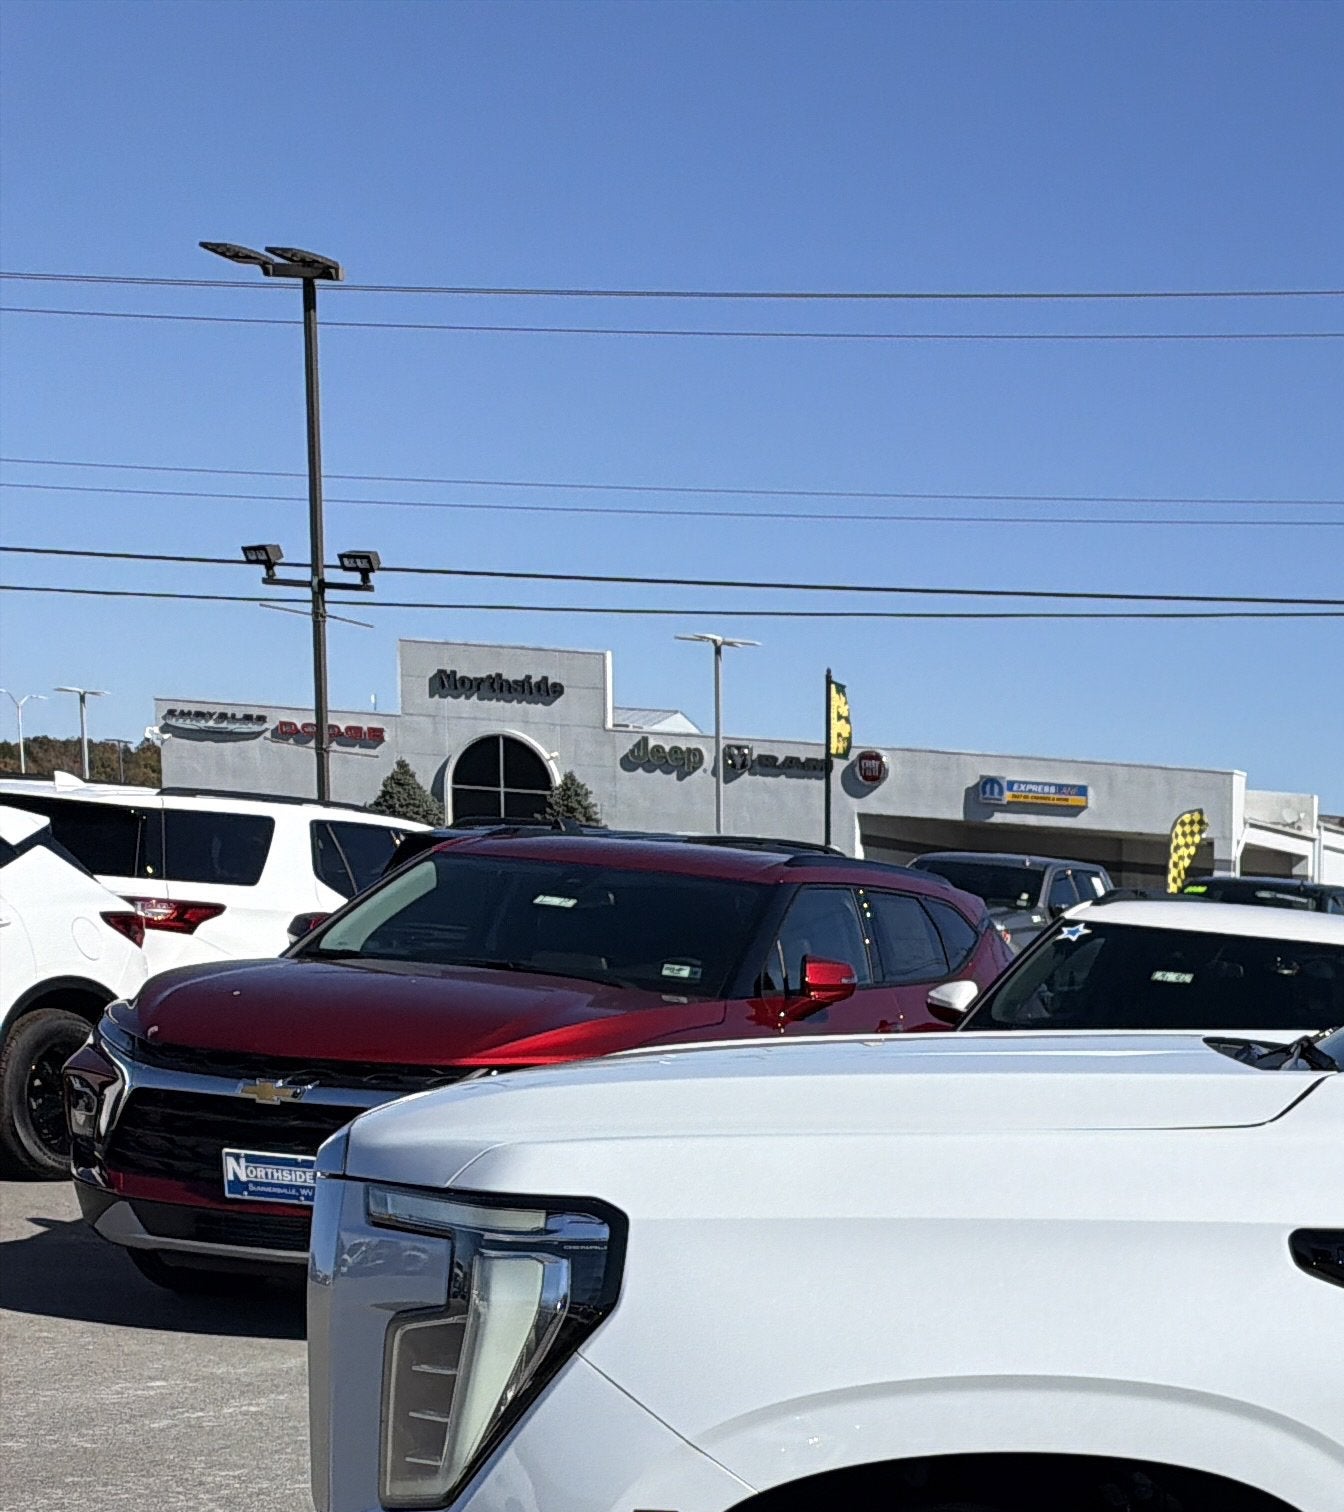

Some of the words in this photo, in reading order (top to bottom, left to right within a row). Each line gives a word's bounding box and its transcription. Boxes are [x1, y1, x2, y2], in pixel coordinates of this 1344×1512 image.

[436, 669, 565, 699] Northside
[628, 735, 705, 772] Jeep
[1012, 783, 1056, 793] EXPRESS
[226, 1156, 315, 1184] NORTHSIDE
